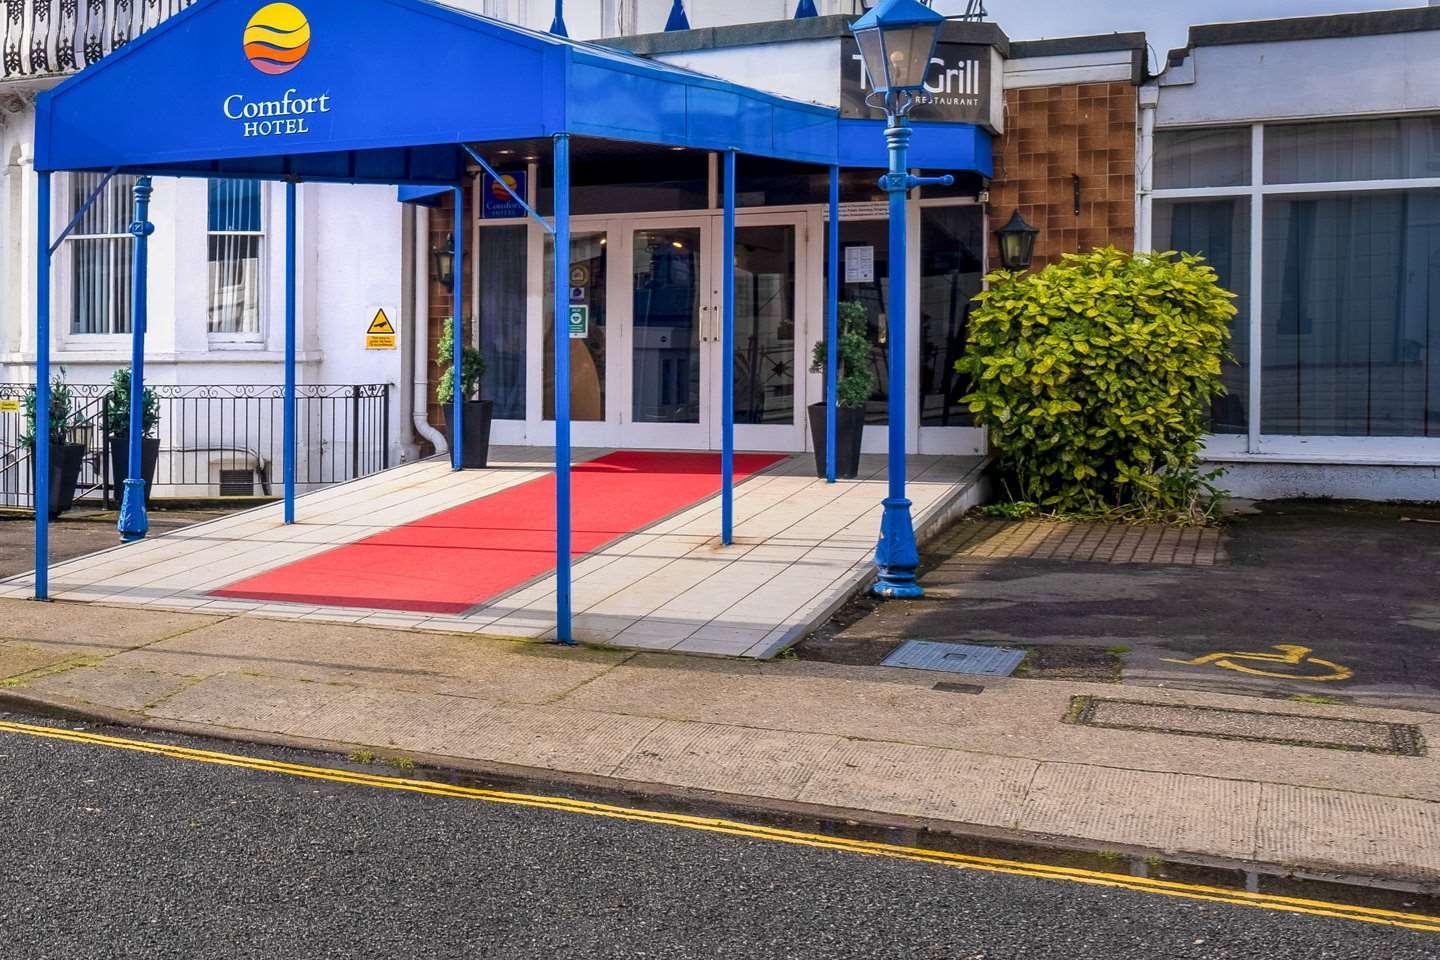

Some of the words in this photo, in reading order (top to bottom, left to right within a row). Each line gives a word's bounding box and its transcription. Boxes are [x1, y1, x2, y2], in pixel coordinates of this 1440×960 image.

[923, 57, 979, 94] Grill
[223, 88, 331, 119] Comfort
[243, 118, 309, 137] HOTEL
